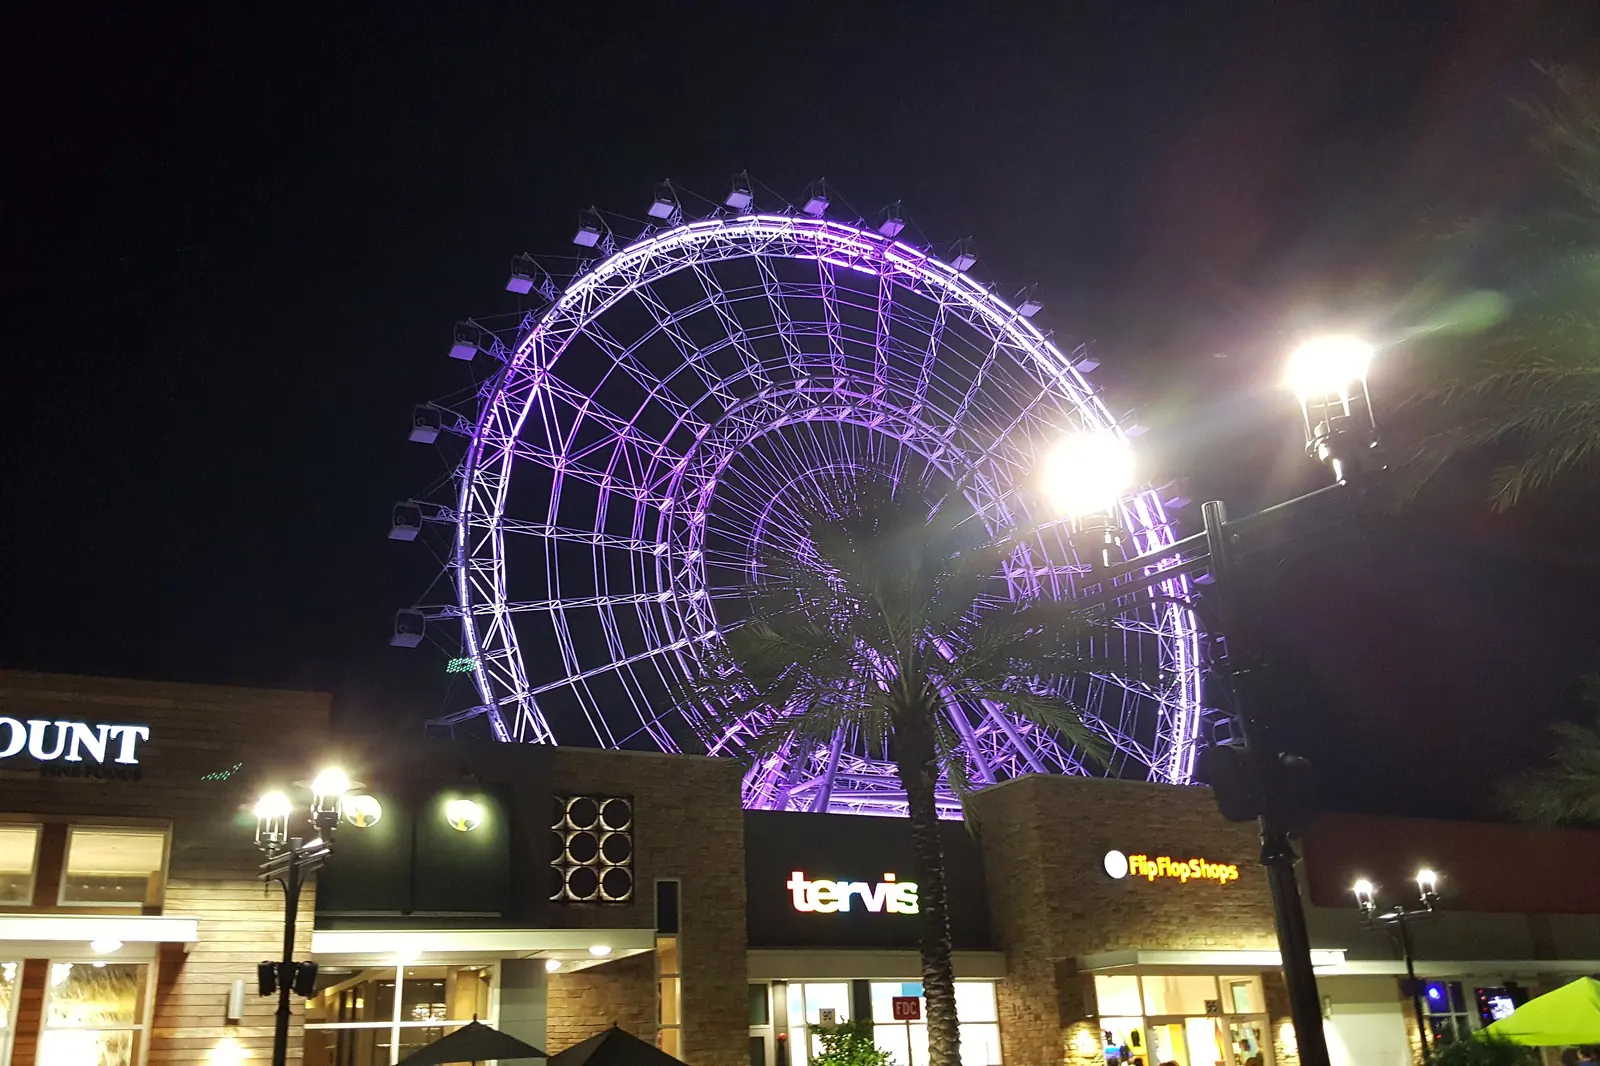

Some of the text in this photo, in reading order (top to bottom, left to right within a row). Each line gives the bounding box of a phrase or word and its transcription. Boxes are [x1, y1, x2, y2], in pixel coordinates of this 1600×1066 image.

[0, 717, 149, 764] OUNT
[786, 871, 919, 914] tervis
[895, 1001, 917, 1016] FDC
